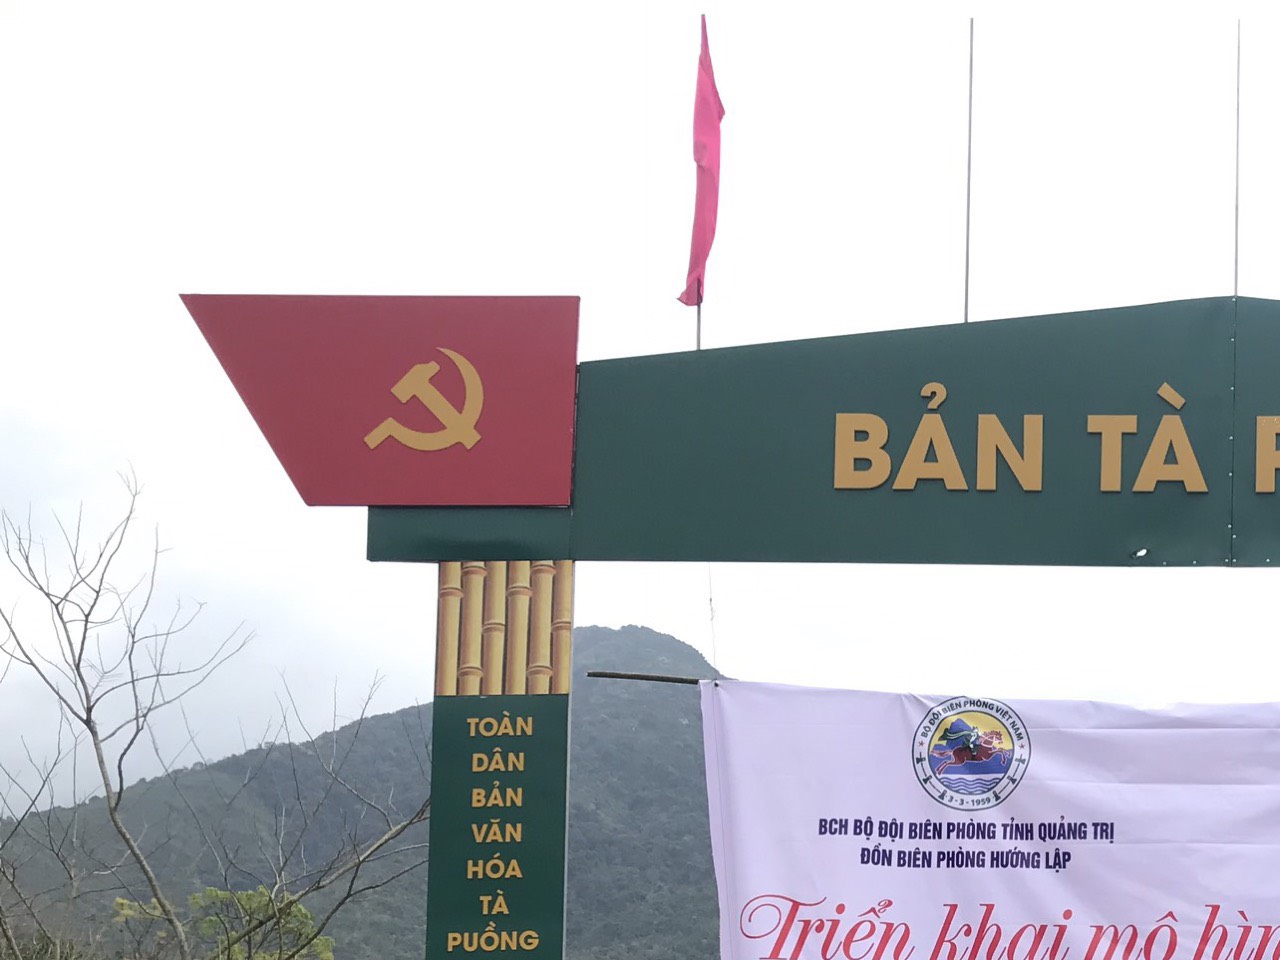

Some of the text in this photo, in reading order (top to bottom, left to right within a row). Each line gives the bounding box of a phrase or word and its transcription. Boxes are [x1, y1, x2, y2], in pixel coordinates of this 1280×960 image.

[834, 382, 1043, 491] BẢN
[1087, 382, 1208, 493] TÀ
[467, 710, 533, 737] TOÀN
[921, 699, 1024, 741] BỘ ĐỘI BIÊN PHÒNG VIỆT NAM
[472, 746, 525, 772] DÂN
[471, 780, 523, 807] BẢN
[471, 818, 523, 843] VĂN
[818, 815, 1115, 844] BCH BỘ ĐỘI BIÊN PHÒNG TỈNH QUẢNG TRỊ
[466, 852, 523, 879] HÓA
[860, 843, 1072, 873] ĐỒN BIÊN PHÒNG HƯỚNG LẬP
[479, 889, 510, 915] TÀ
[447, 921, 540, 952] PUỒNG
